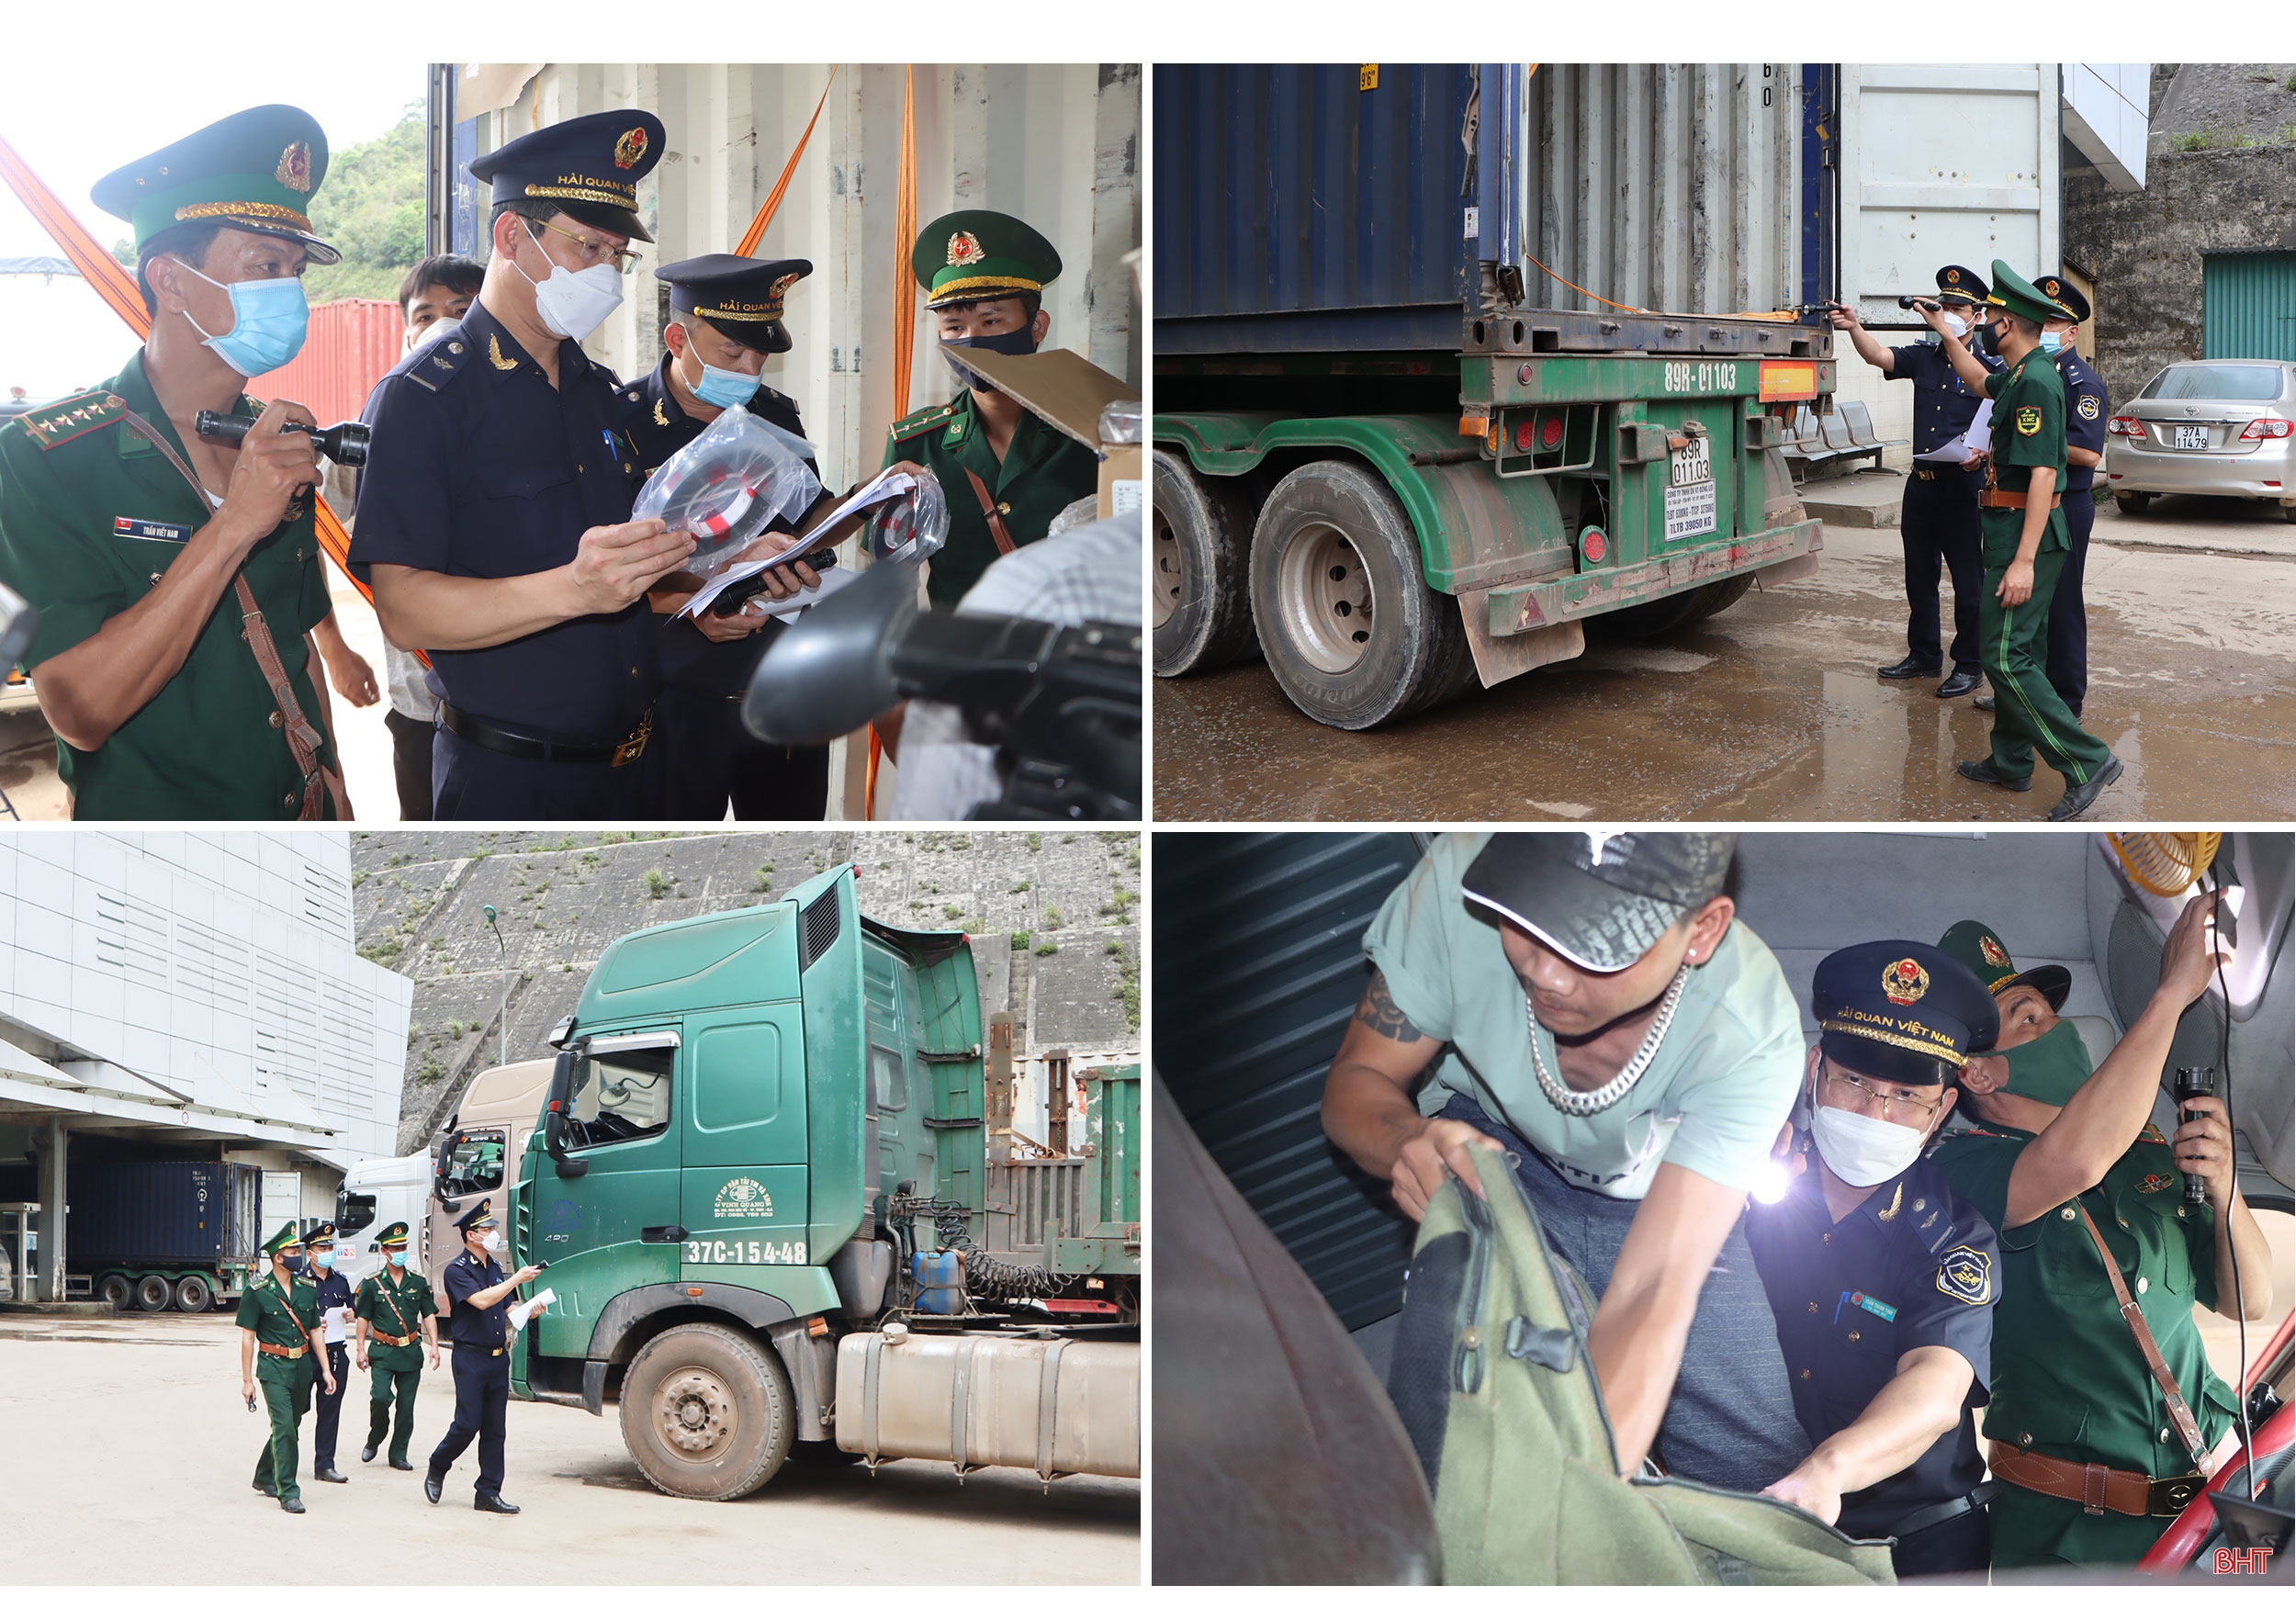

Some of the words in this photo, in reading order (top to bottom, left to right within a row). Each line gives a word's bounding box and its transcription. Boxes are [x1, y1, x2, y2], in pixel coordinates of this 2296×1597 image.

[557, 172, 583, 186] HẢI
[585, 177, 620, 191] QUAN
[719, 298, 740, 311] HẢI
[742, 303, 771, 312] QUAN
[2183, 426, 2200, 438] 37A
[2177, 437, 2208, 450] 114.79
[1673, 459, 1709, 483] 011.03
[1670, 522, 1684, 534] TLTB
[1684, 518, 1704, 531] 39050
[1704, 516, 1712, 527] KG
[166, 529, 179, 539] NAM
[1837, 1006, 1853, 1018] HẢI
[1853, 1011, 1894, 1028] QUAN
[1897, 1019, 1930, 1037] VIỆT
[1930, 1029, 1955, 1048] NAM
